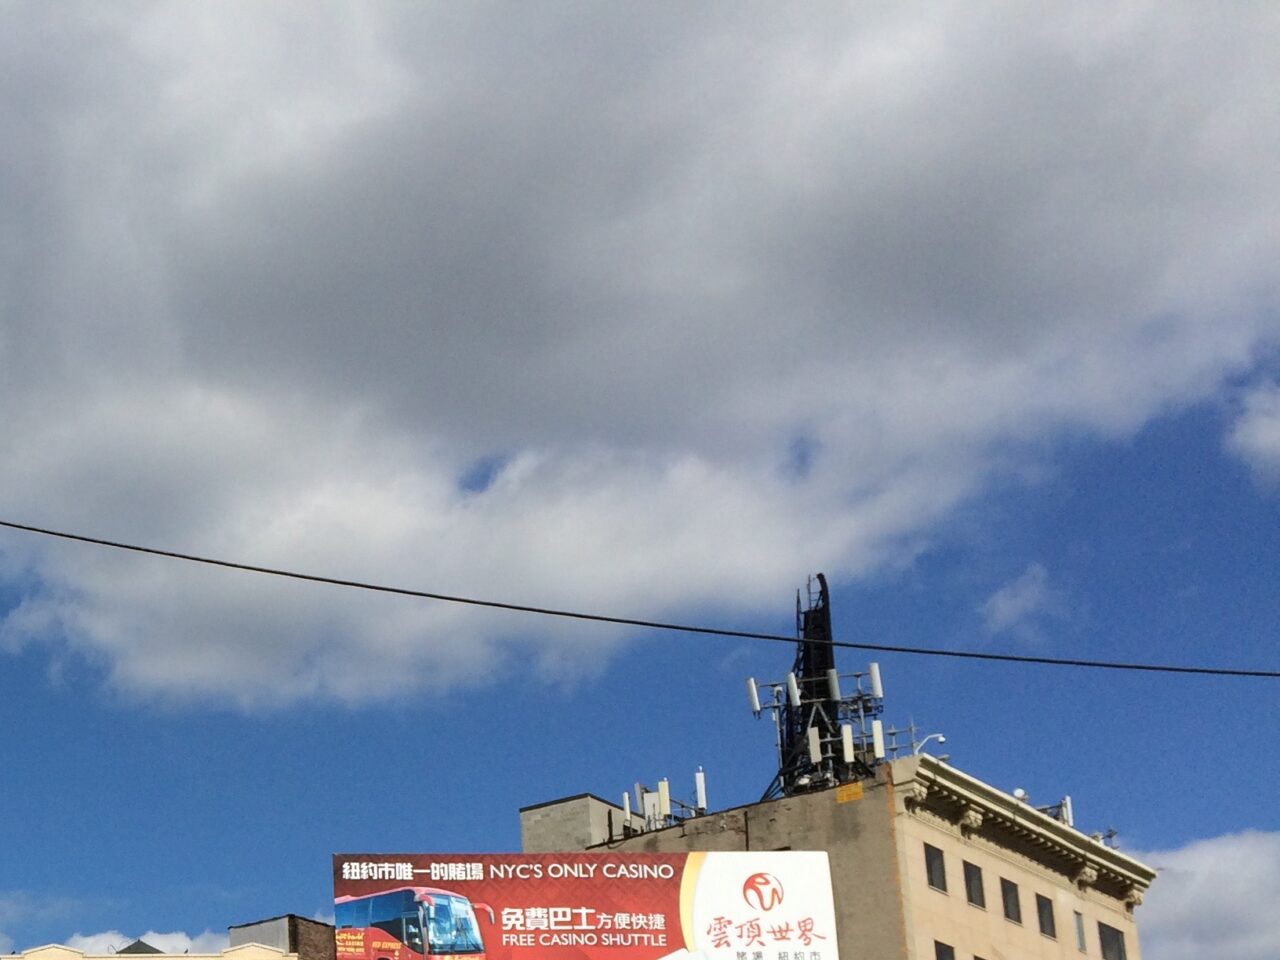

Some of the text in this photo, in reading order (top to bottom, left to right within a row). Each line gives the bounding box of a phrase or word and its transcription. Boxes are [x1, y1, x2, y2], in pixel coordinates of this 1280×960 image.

[342, 863, 484, 881] 紐約市唯一的賭場
[489, 863, 674, 880] NYC'S ONLY CASINO
[502, 932, 667, 947] FREE CASINO SHUTTLE
